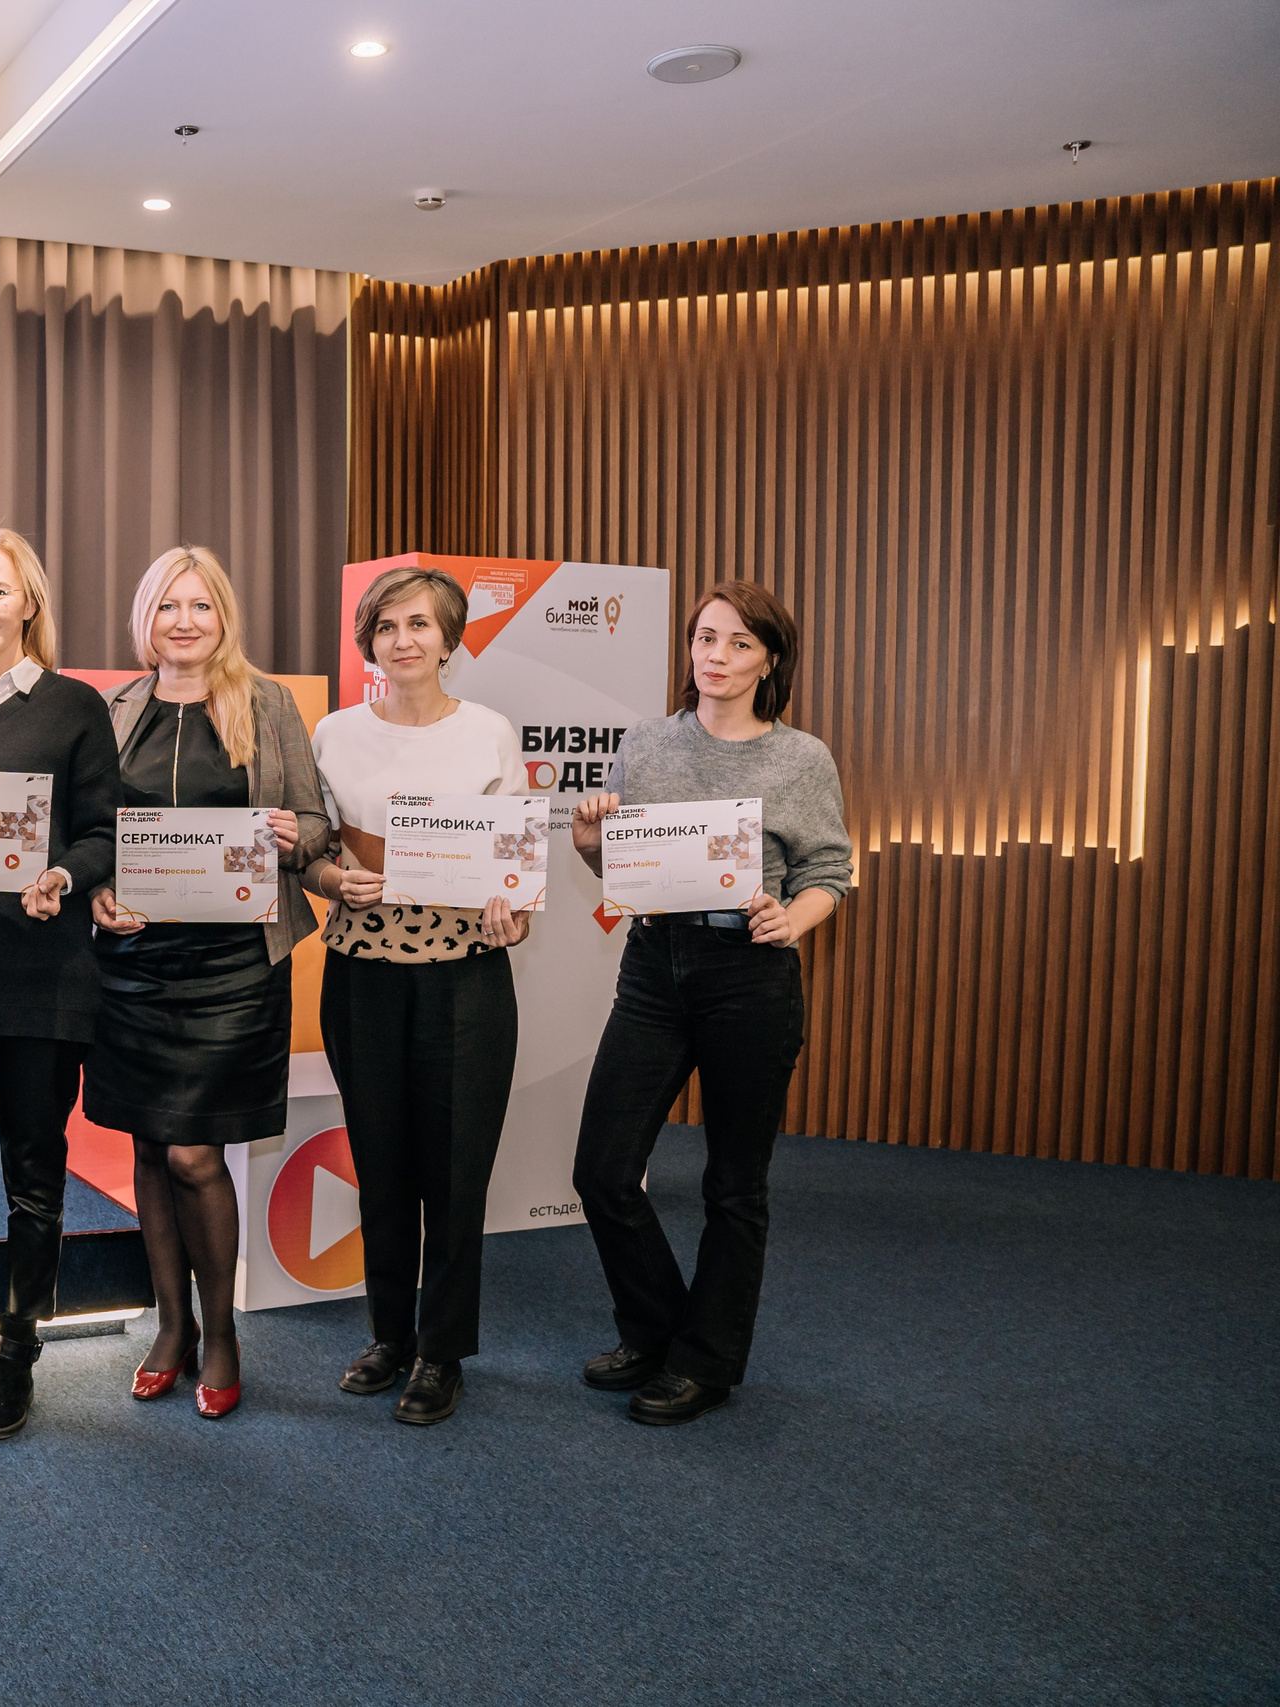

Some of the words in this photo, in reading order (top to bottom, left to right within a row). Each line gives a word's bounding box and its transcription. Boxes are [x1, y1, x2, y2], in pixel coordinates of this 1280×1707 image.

[475, 583, 513, 592] НАЦИОНАЛЬНЫЕ
[546, 607, 598, 625] бизнес
[391, 816, 495, 832] СЕРТИФИКАТ
[606, 824, 708, 841] СЕРТИФИКАТ
[121, 833, 224, 845] СЕРТИФИКАТ
[390, 849, 424, 858] Татьяне
[426, 851, 471, 860] Бутаковой
[607, 862, 631, 870] Юлии
[633, 860, 661, 868] Майер
[154, 867, 206, 875] Бересневой
